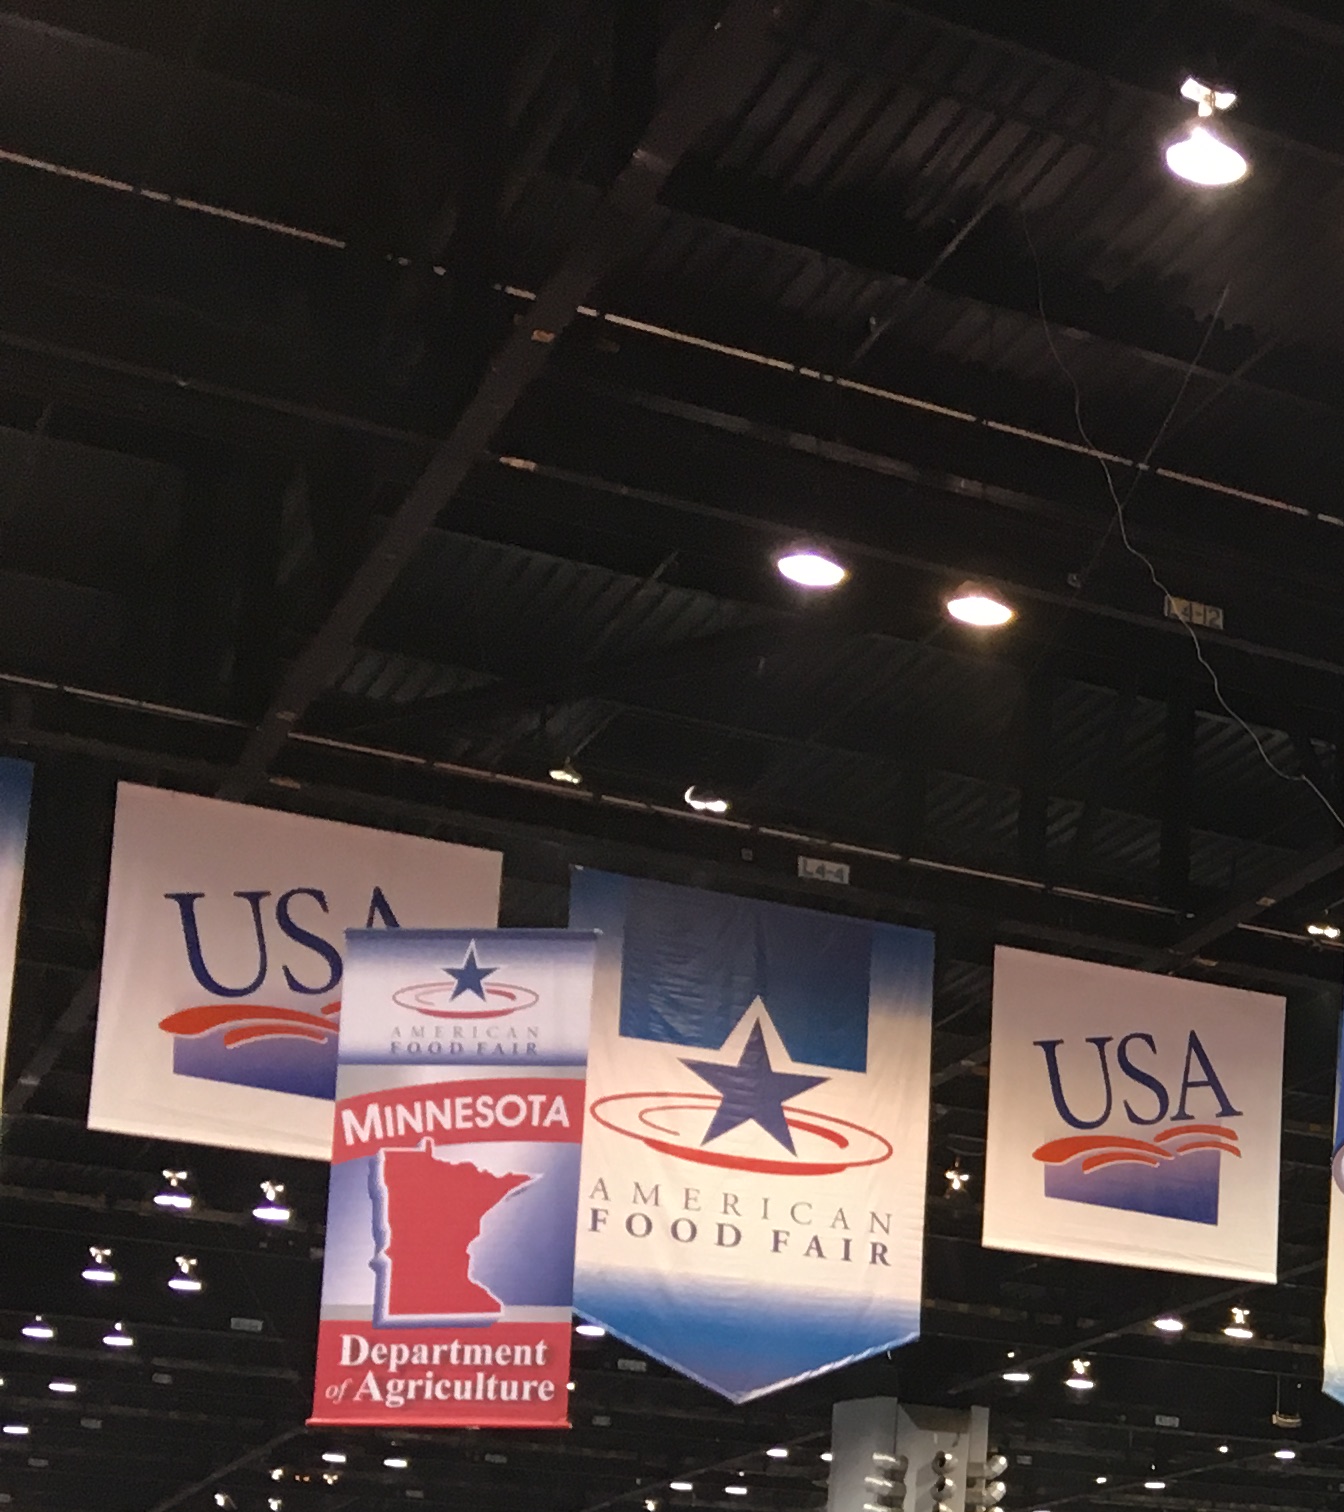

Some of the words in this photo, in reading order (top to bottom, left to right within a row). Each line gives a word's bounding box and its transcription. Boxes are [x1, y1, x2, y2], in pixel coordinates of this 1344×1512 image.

[391, 1025, 539, 1039] AMERICAN
[391, 1041, 465, 1056] FOOD
[477, 1042, 539, 1057] FAIR
[1033, 1030, 1244, 1130] USA
[341, 1095, 571, 1146] MINNESOTA
[590, 1176, 893, 1235] AMERICAN
[590, 1207, 742, 1249] FOOD
[771, 1228, 892, 1266] FAIR
[339, 1333, 547, 1373] Department
[324, 1377, 356, 1405] of
[355, 1370, 556, 1408] Agriculture
